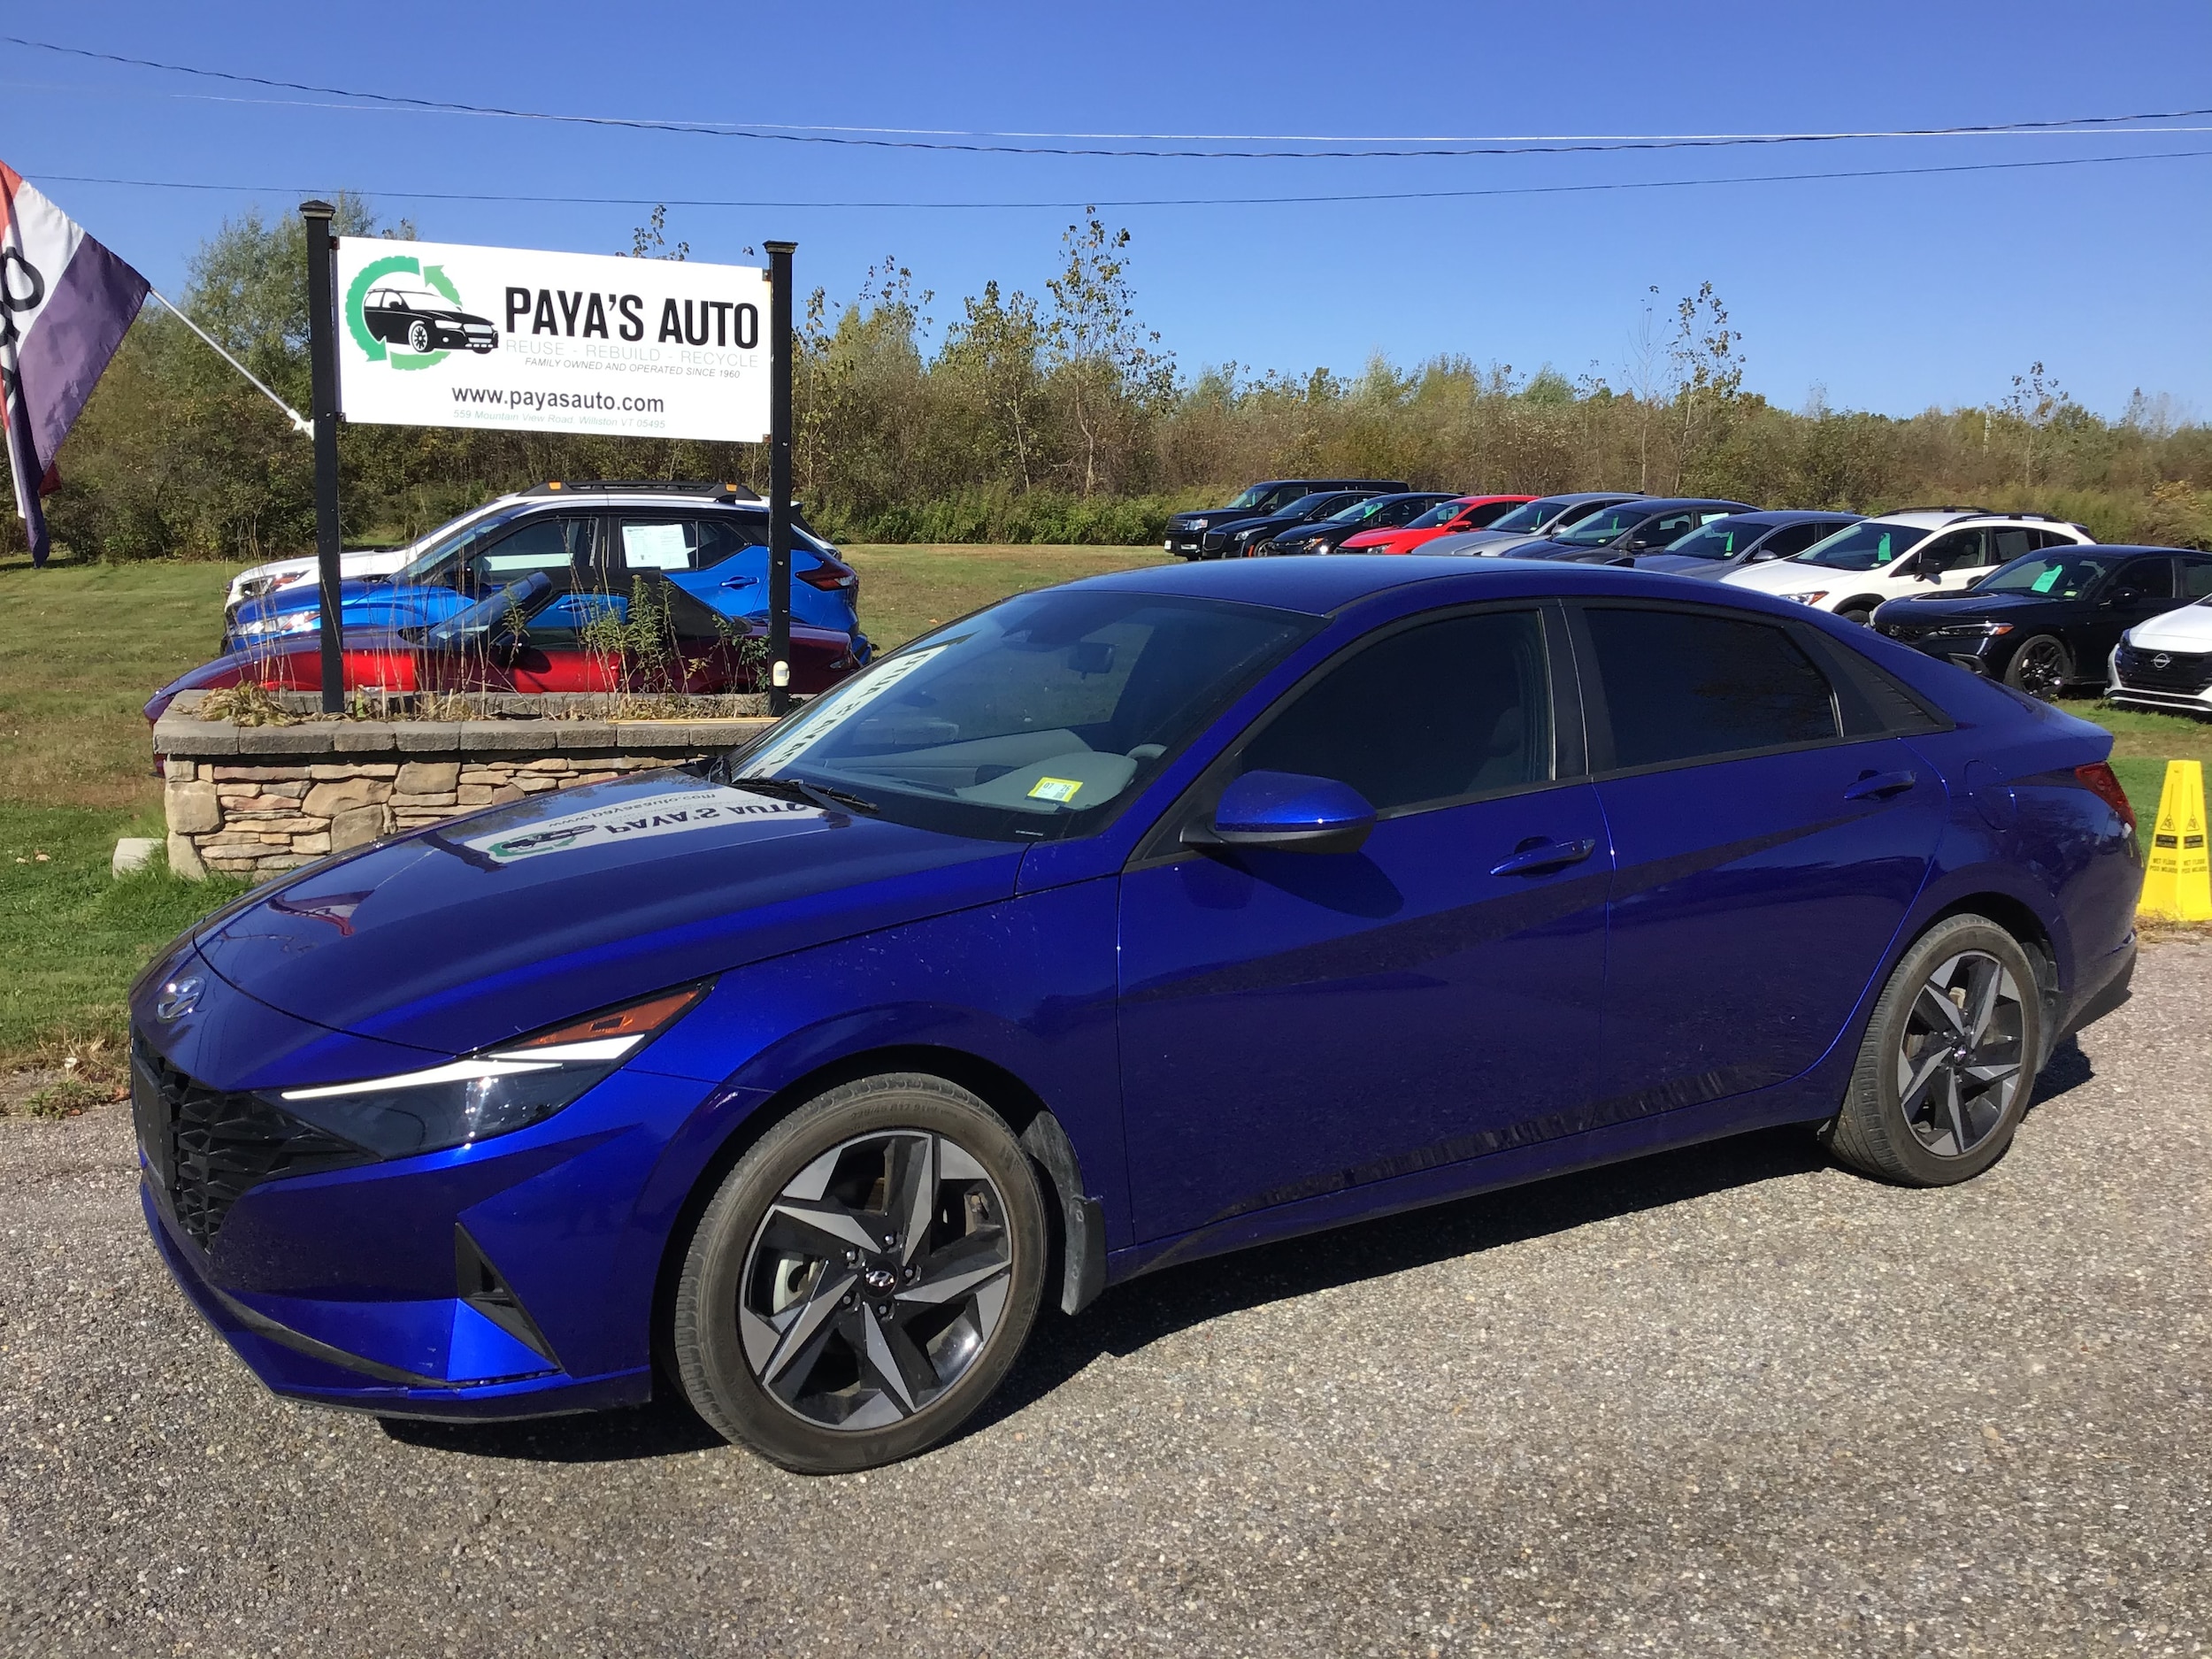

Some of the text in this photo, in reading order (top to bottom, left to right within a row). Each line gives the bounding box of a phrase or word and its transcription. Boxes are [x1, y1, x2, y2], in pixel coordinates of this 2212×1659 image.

[505, 286, 758, 349] PAYA'S AUTO
[506, 340, 565, 356] REUSE
[586, 344, 661, 362] REBUILD
[680, 349, 758, 367] RECYCLE
[525, 357, 741, 379] FAMILY OWNED AND OPERATED SINCE 1960
[451, 387, 664, 412] www.payasauto.com
[453, 409, 472, 419] 559
[474, 411, 518, 421] Mountain
[522, 413, 545, 422] View
[579, 416, 618, 426] Williston
[620, 418, 634, 426] VT
[636, 419, 665, 428] 05495
